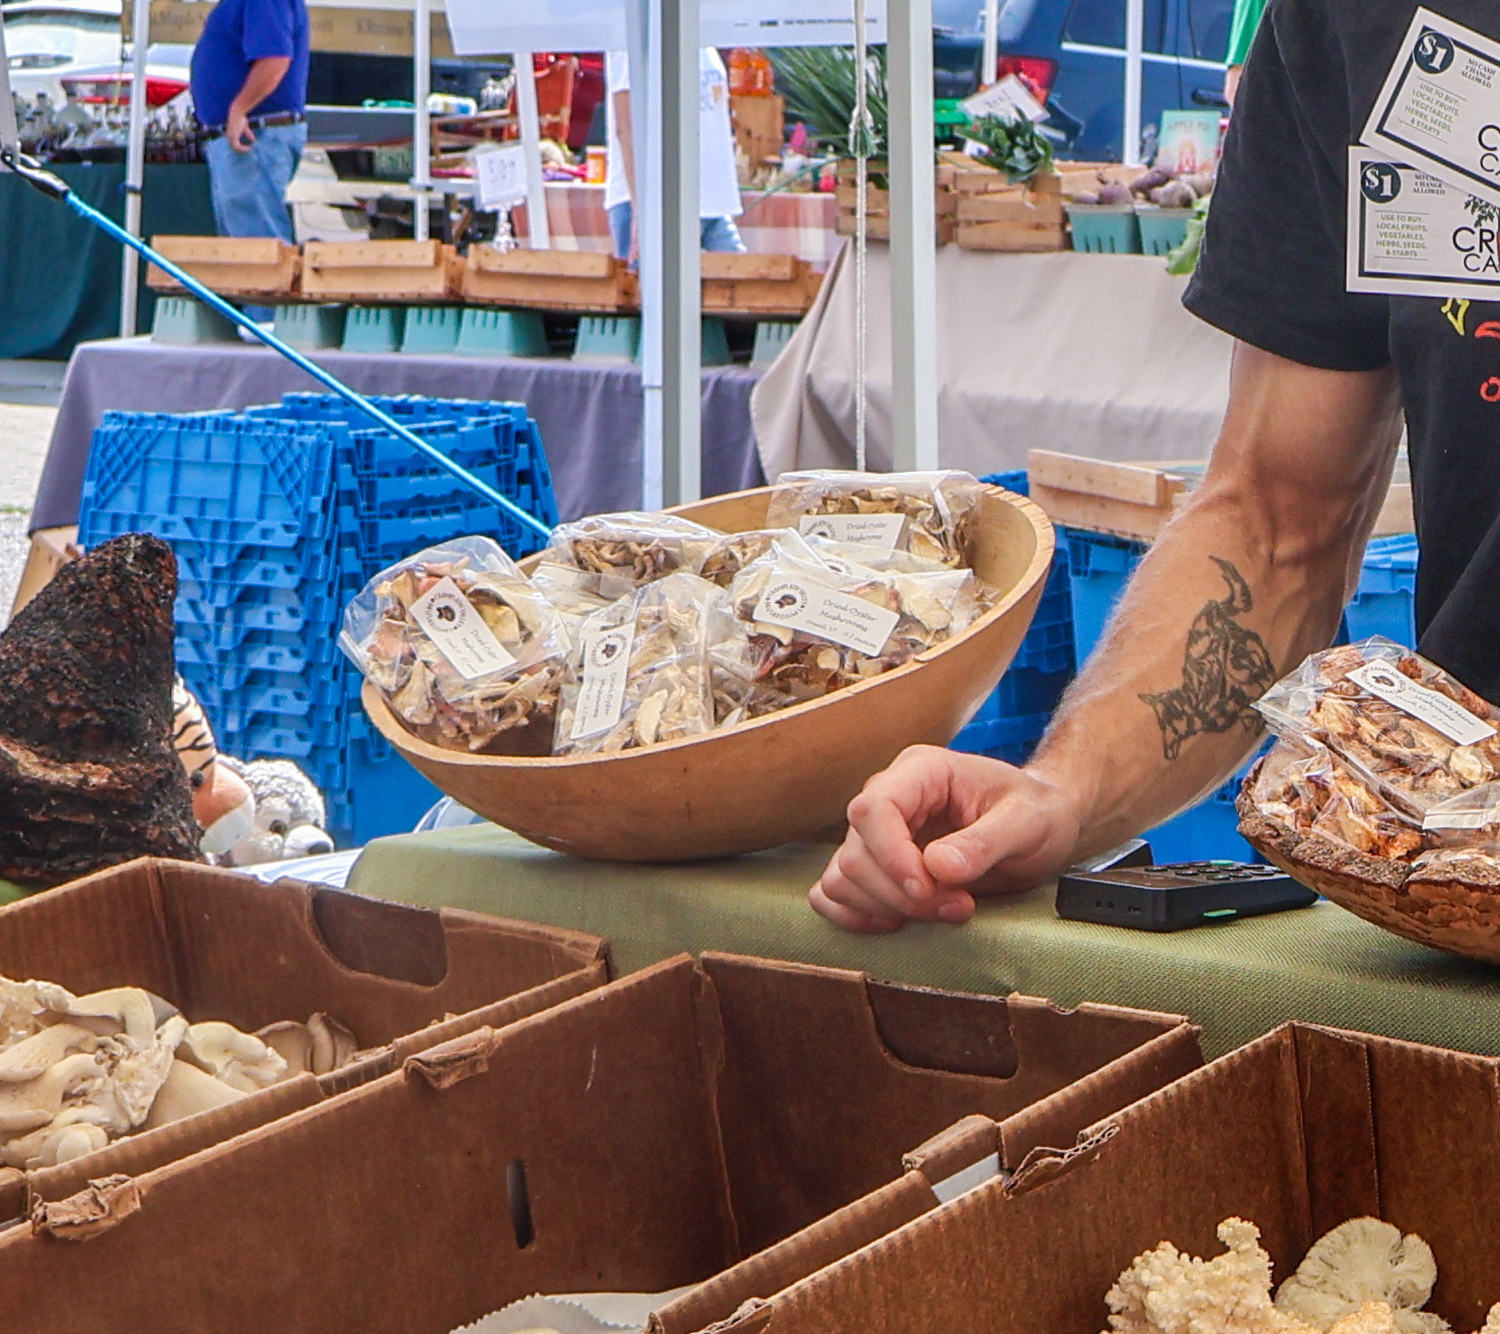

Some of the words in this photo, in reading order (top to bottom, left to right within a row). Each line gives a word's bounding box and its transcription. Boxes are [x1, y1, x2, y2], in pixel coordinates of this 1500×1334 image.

[1418, 35, 1447, 70] $1
[1461, 71, 1491, 88] ALLOWED
[1412, 90, 1434, 105] LOCAL
[1365, 167, 1393, 196] $1
[823, 599, 849, 612] Dried
